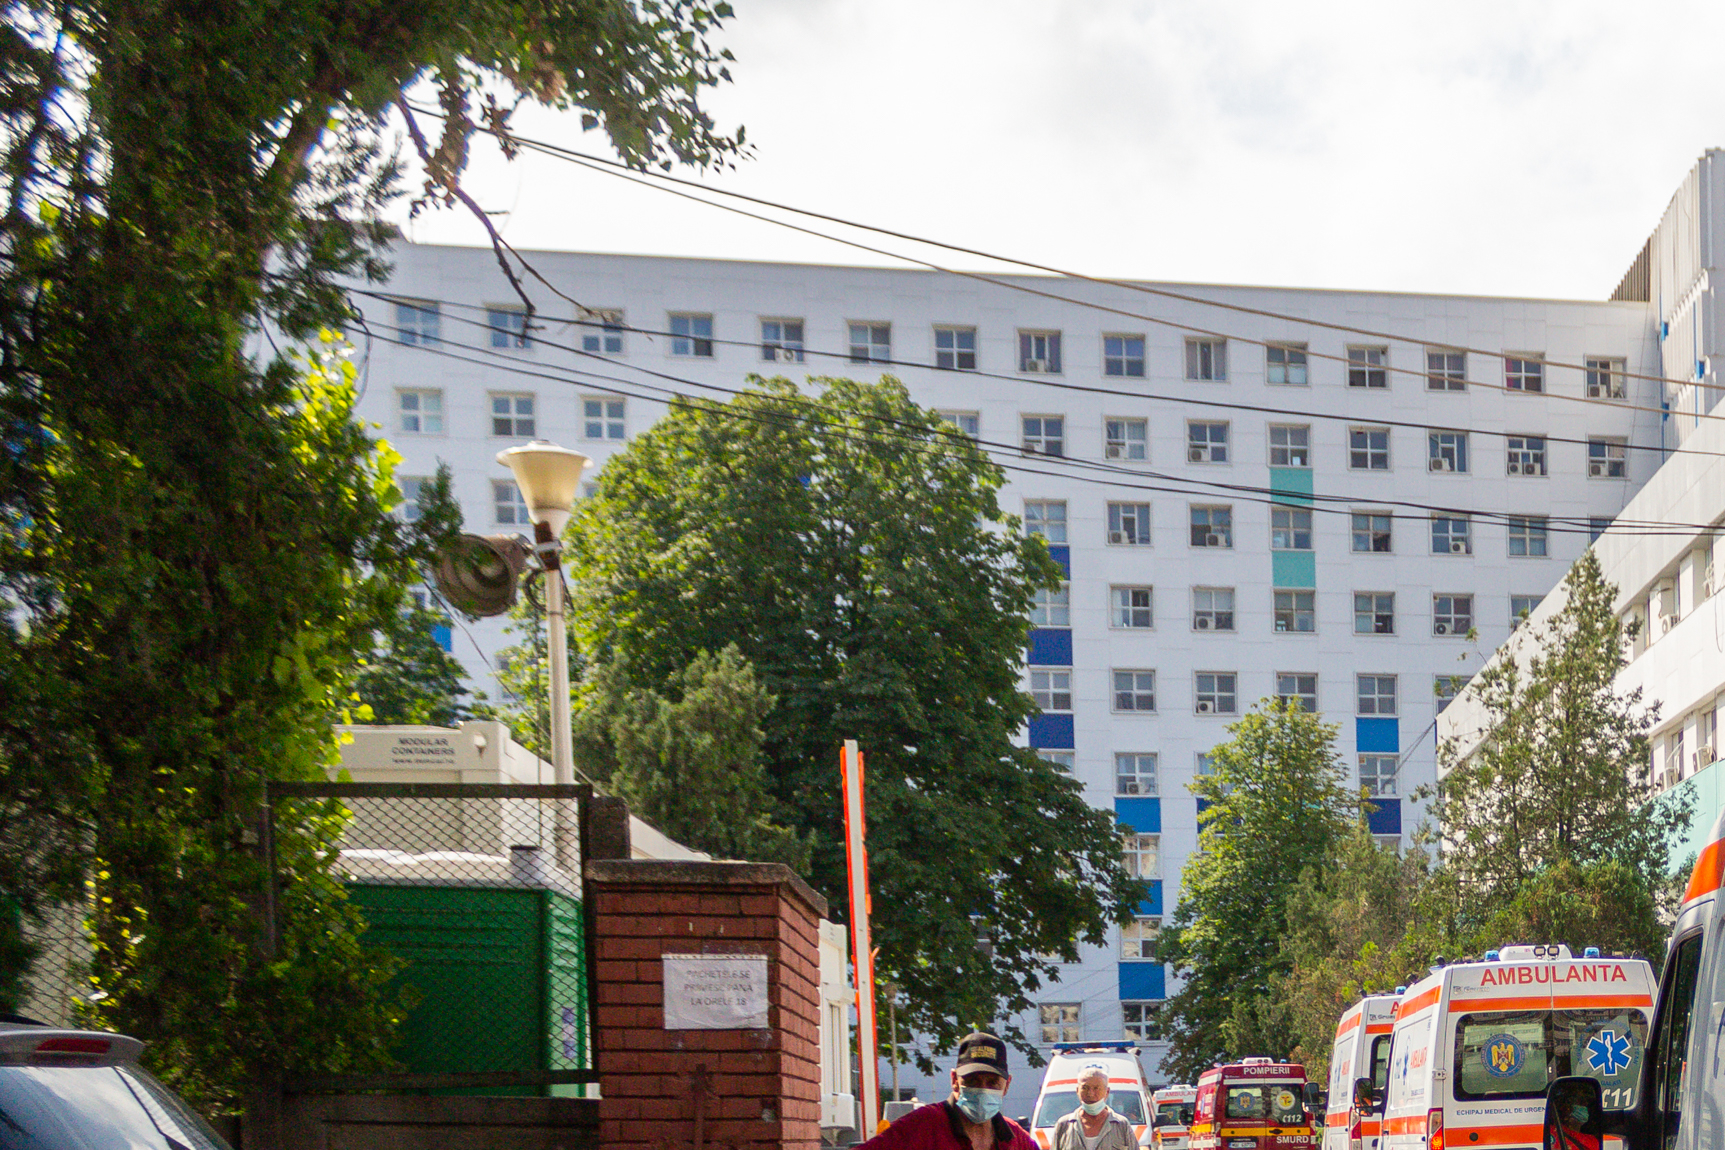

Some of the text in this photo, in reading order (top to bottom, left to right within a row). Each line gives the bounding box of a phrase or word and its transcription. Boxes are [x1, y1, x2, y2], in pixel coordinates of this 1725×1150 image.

[391, 747, 456, 755] CONTAINERS
[1480, 964, 1628, 986] AMBULANTA
[1243, 1066, 1290, 1075] POMPIERII
[1611, 1087, 1632, 1107] 11
[1285, 1114, 1302, 1123] 112
[1276, 1135, 1309, 1144] SMURD
